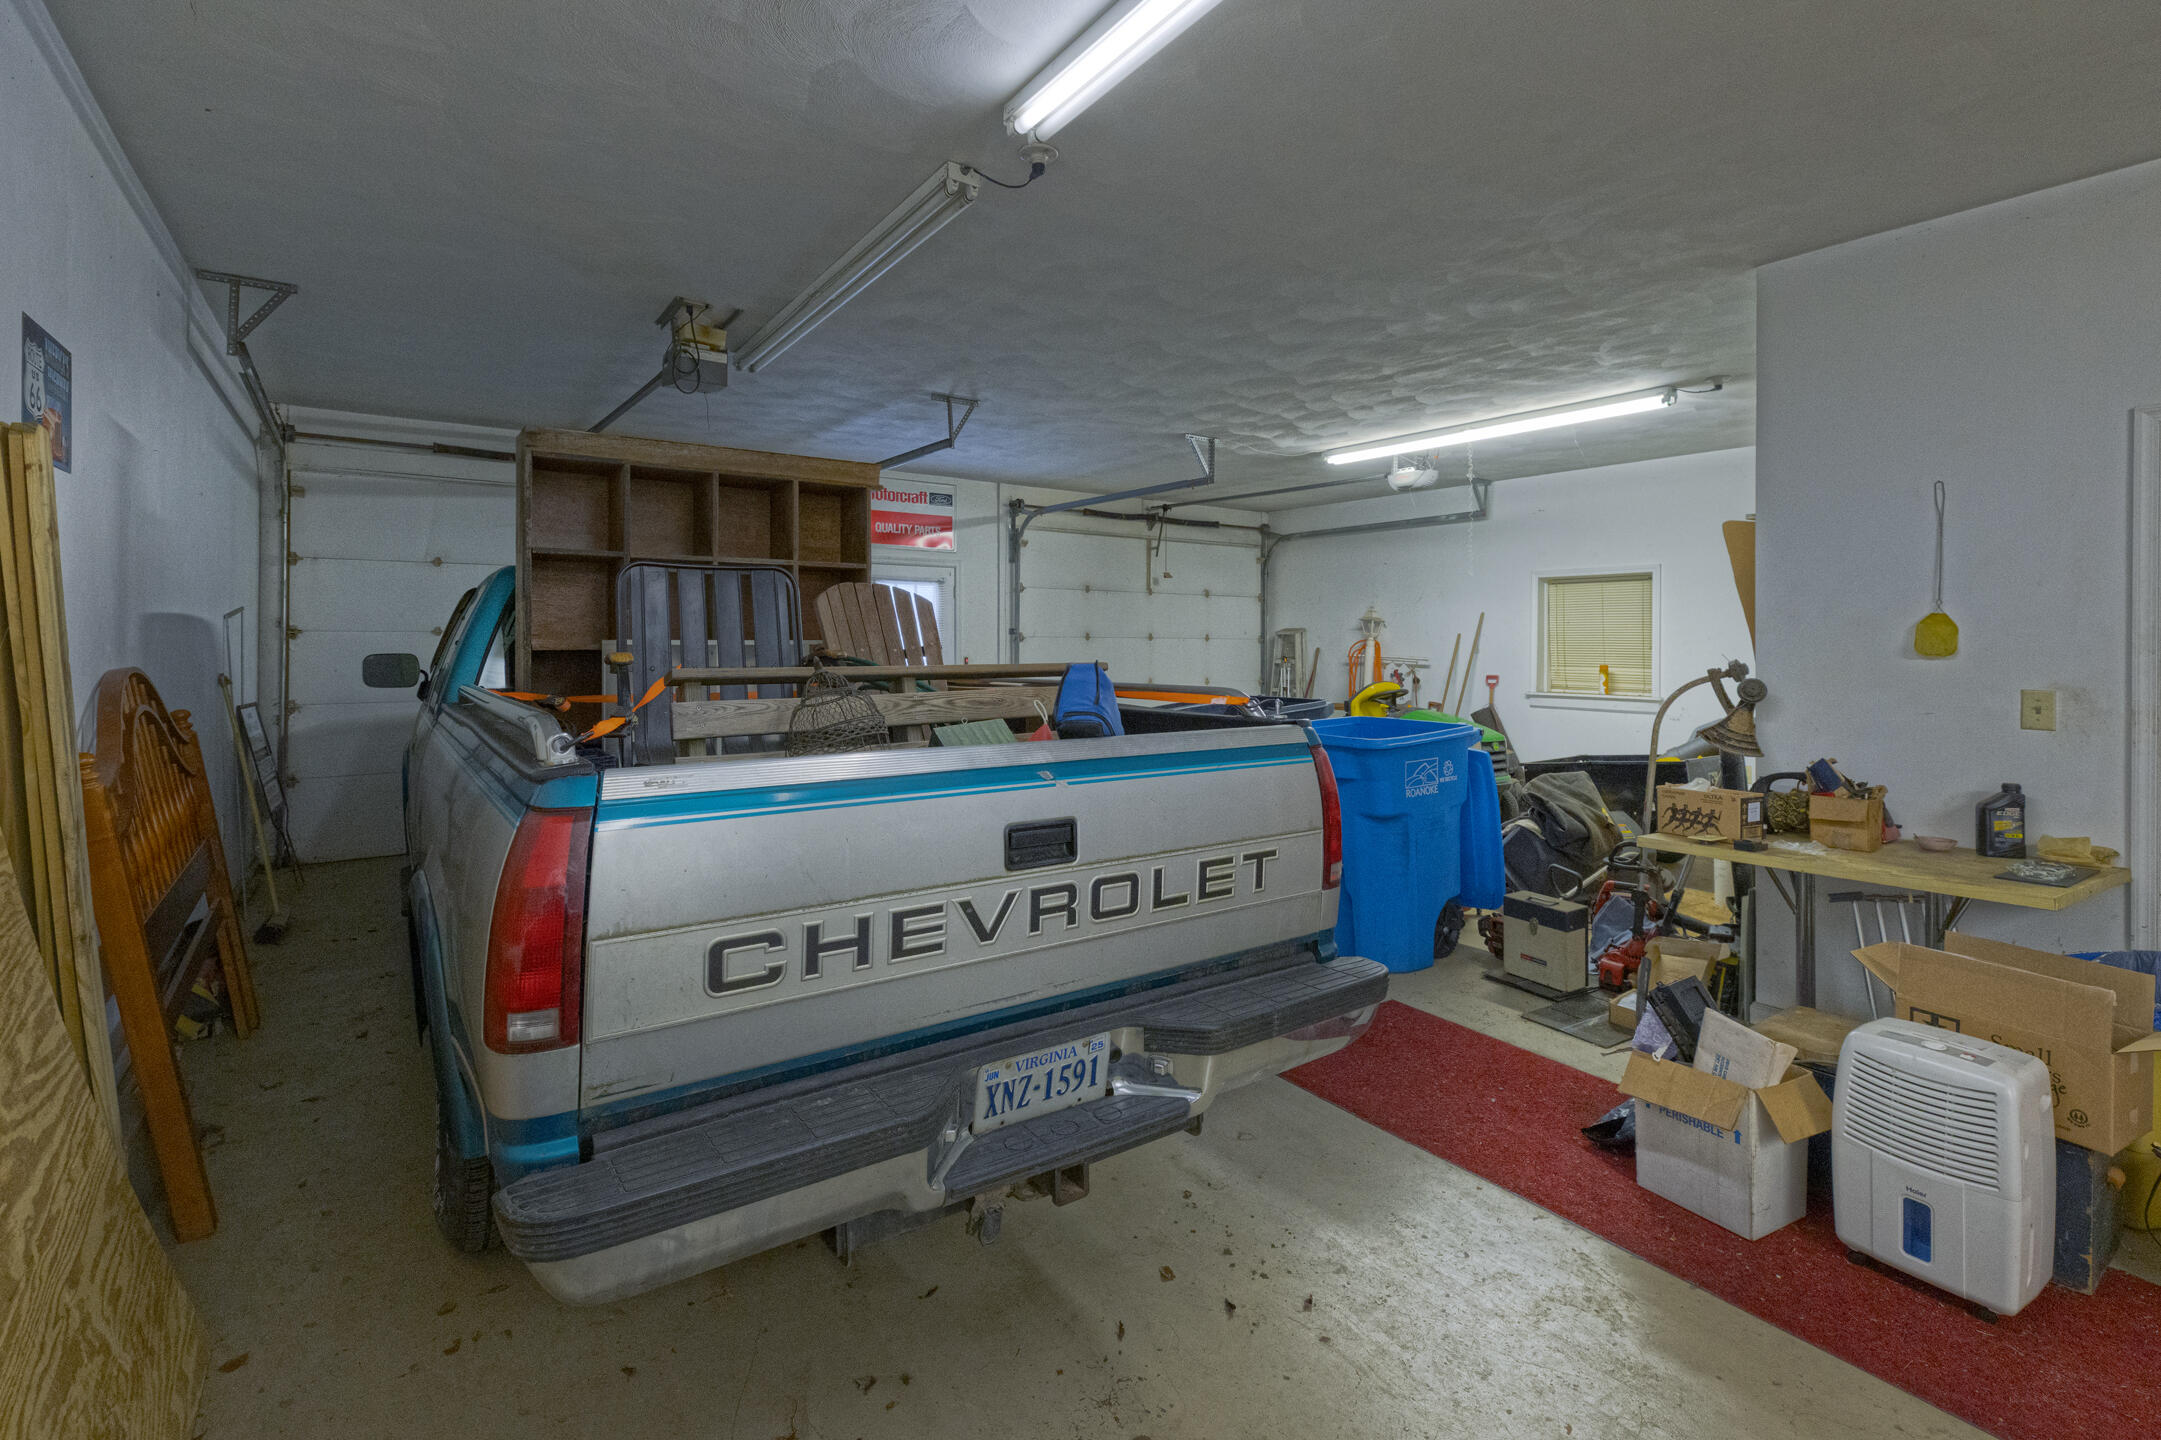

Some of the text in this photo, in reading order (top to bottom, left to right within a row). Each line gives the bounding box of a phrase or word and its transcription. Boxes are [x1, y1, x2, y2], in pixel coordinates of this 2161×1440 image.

[29, 383, 42, 412] 66
[874, 521, 942, 536] QUALITY PARTS
[1405, 785, 1439, 798] ROANOKE
[706, 849, 1280, 996] CHEVROLET
[1090, 1040, 1104, 1051] 25
[1015, 1046, 1078, 1073] VIRGINIA
[984, 1069, 1000, 1082] JUN
[983, 1055, 1099, 1120] XNZ-1591
[1658, 1105, 1725, 1139] PERISHABLE
[1905, 1184, 1928, 1197] Haier
